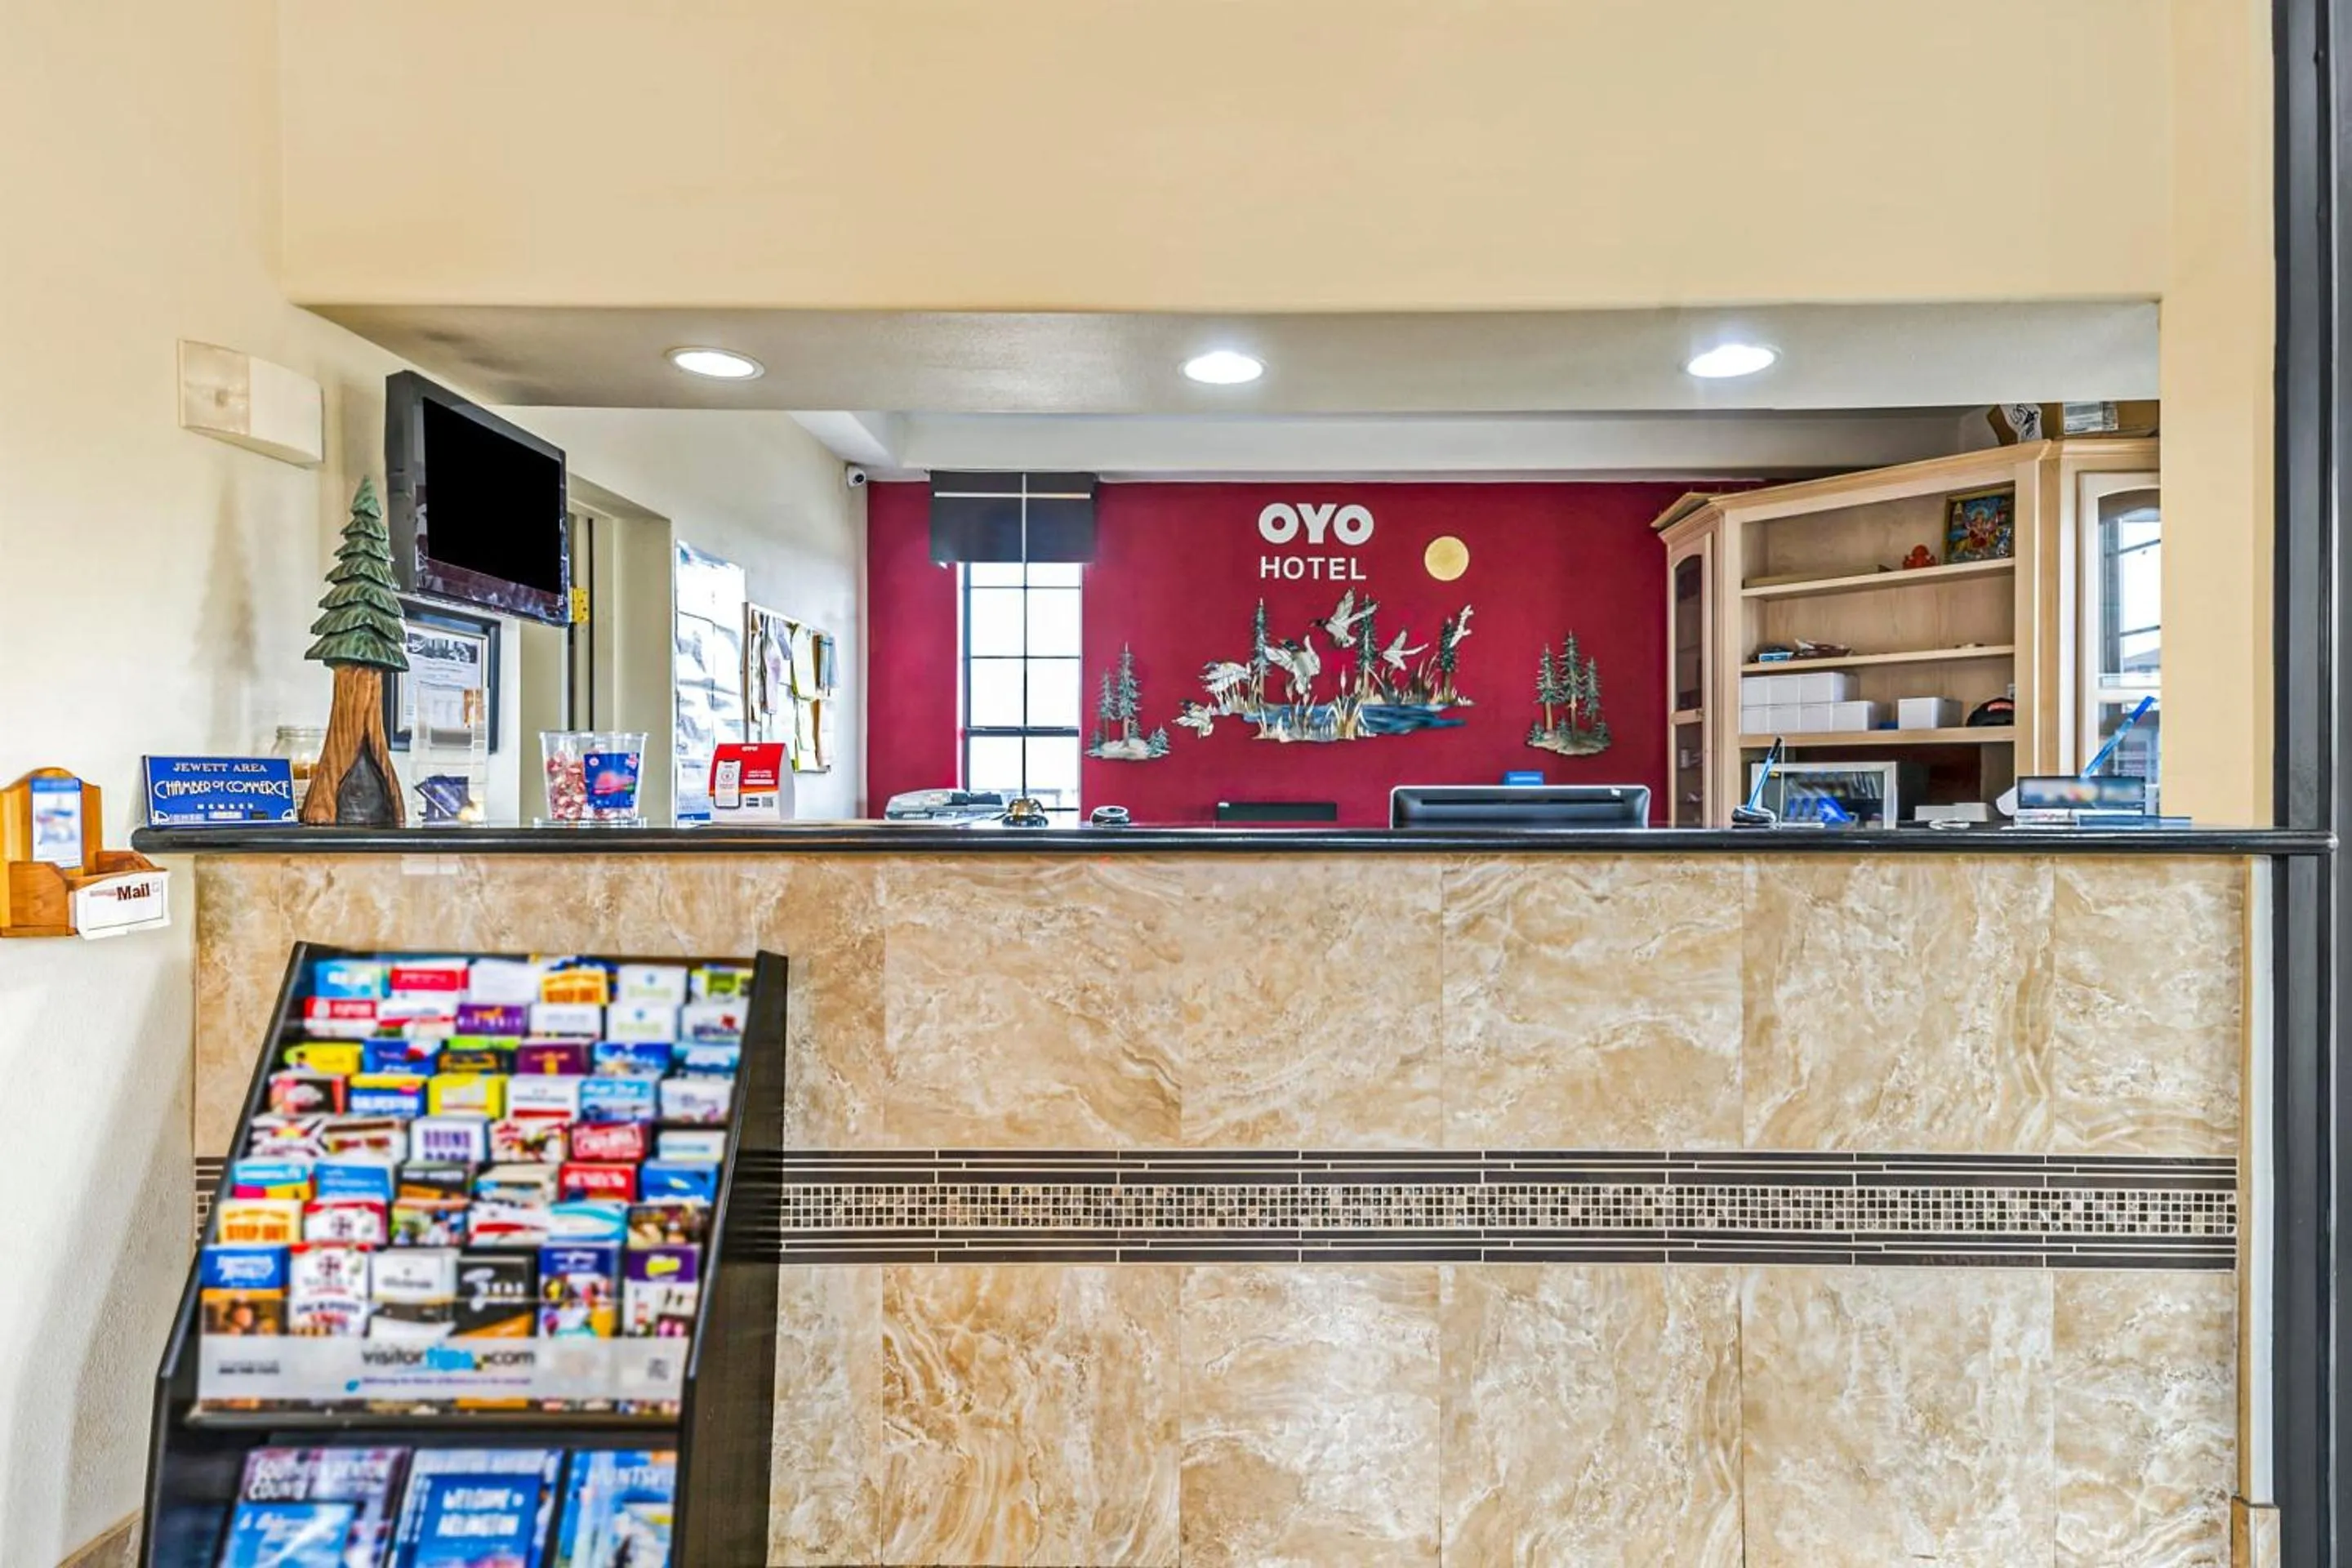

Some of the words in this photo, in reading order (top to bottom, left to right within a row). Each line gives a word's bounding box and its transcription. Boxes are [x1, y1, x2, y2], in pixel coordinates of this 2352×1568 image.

[1258, 502, 1374, 546] OYO
[1260, 555, 1367, 581] HOTEL
[172, 762, 229, 773] JEWETT
[233, 763, 269, 773] AREA
[154, 780, 212, 800] CHAMBER
[226, 780, 291, 800] COMMERCE
[116, 882, 151, 902] Mail
